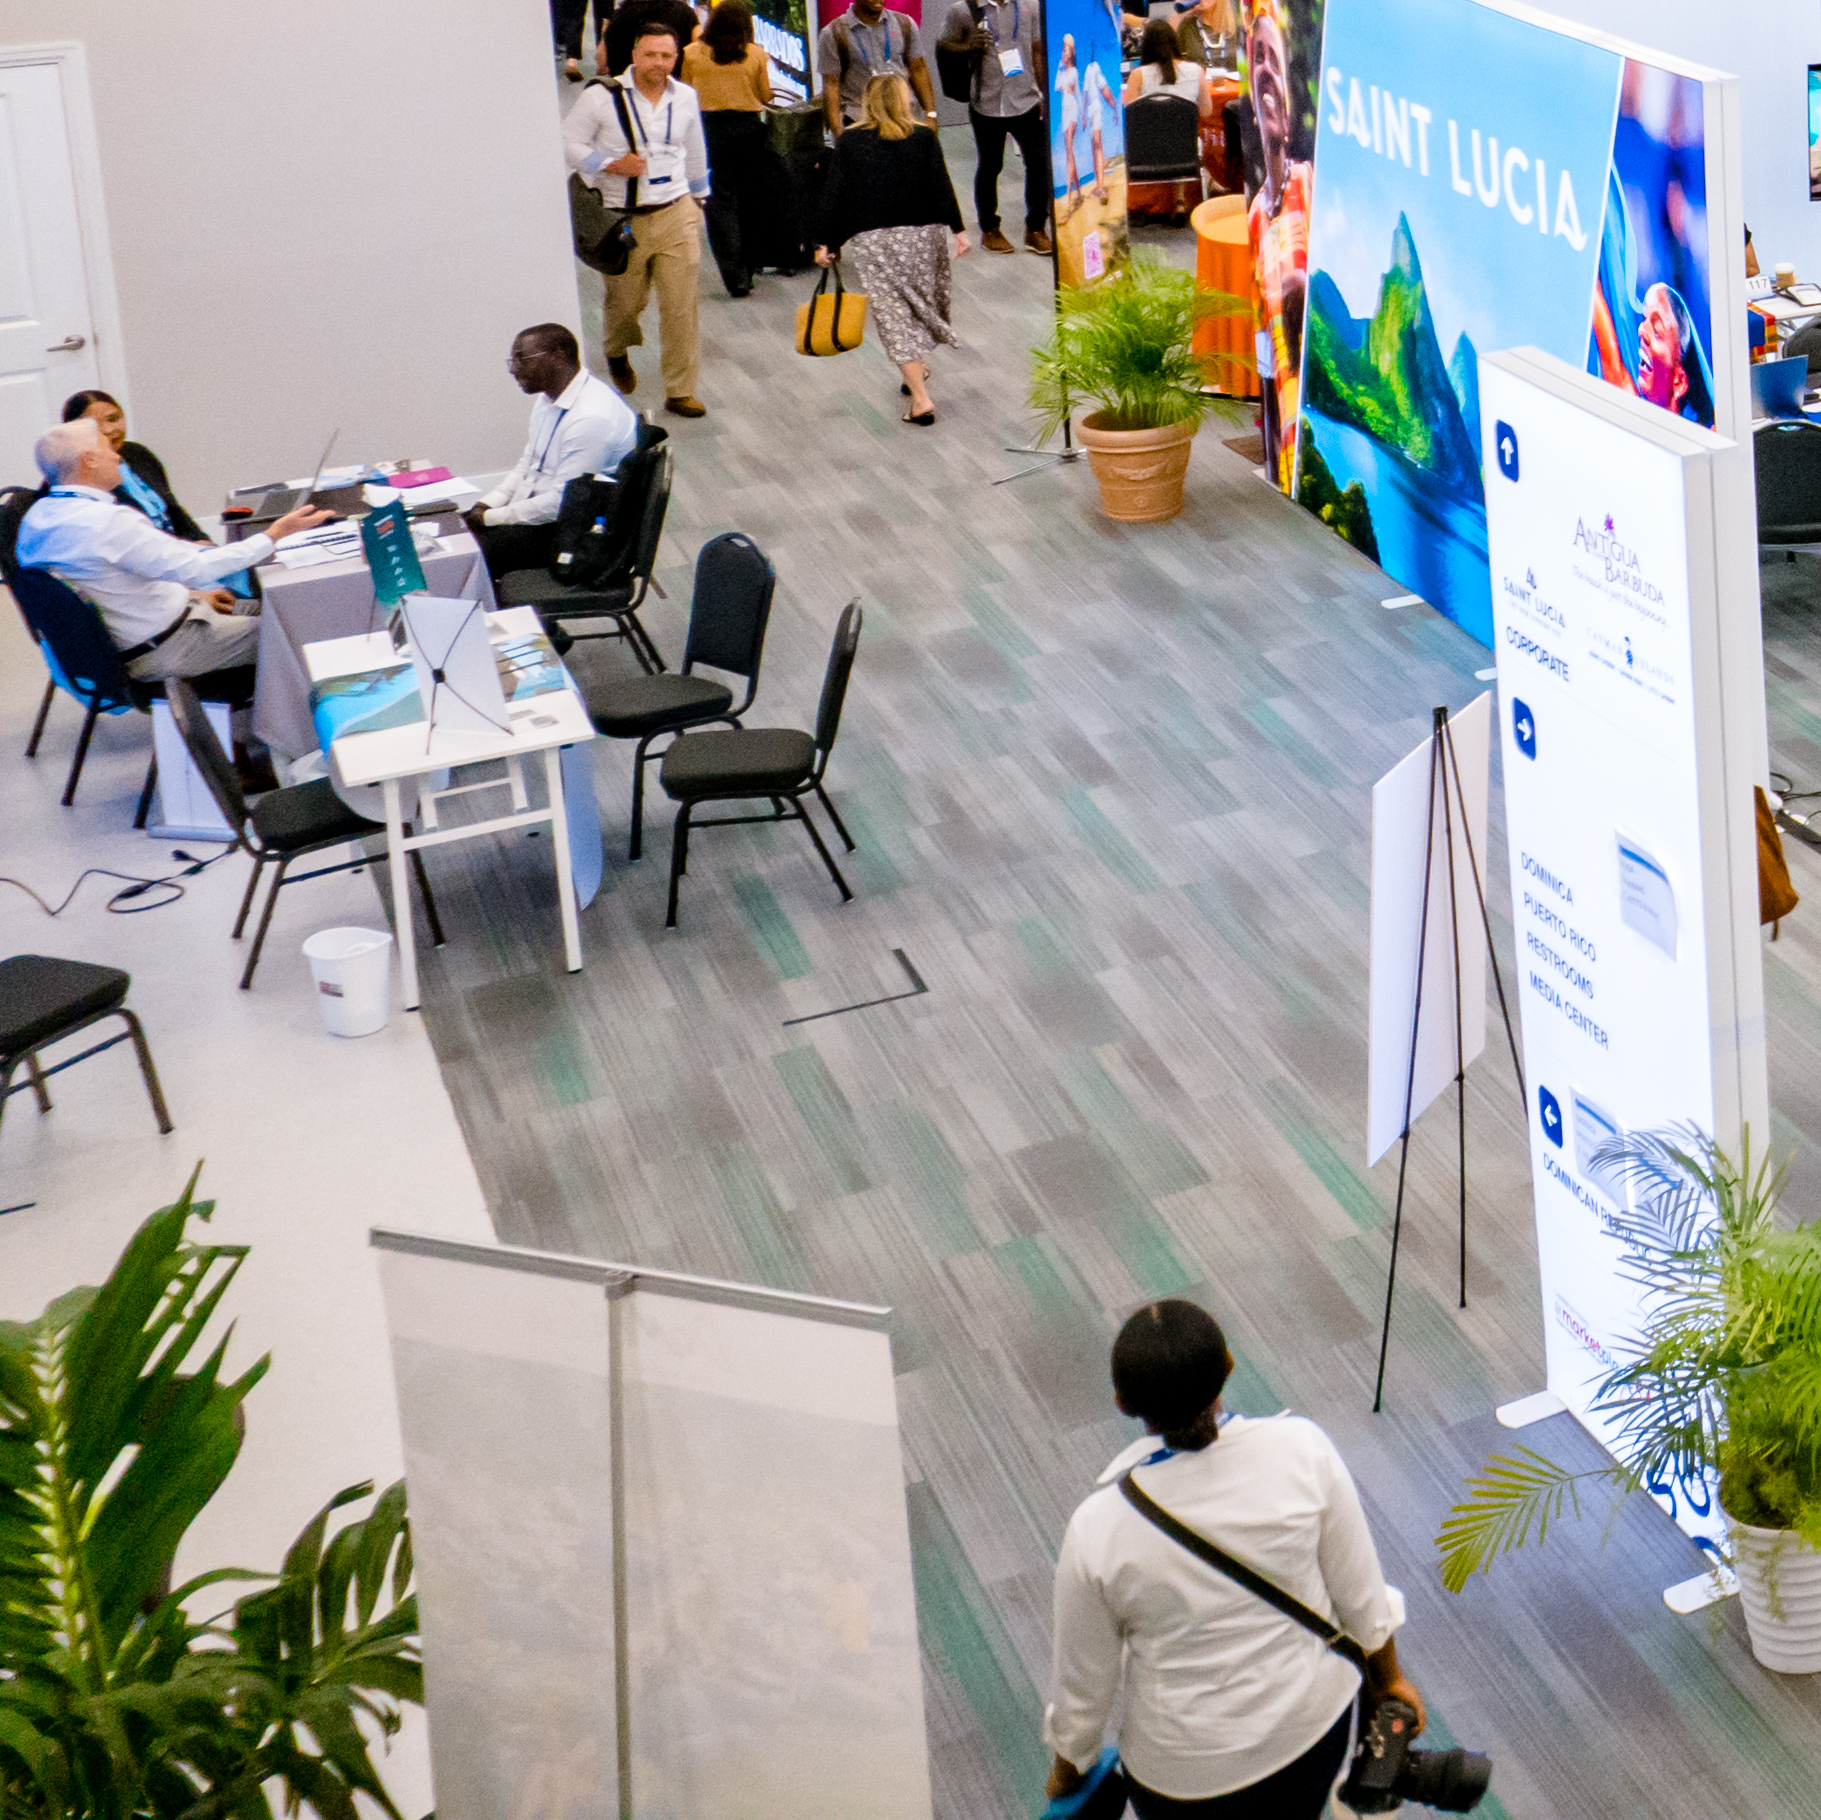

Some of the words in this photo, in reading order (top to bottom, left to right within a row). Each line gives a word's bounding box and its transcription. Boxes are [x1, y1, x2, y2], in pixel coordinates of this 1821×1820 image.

[1325, 64, 1433, 180] SAINT
[1448, 115, 1587, 253] LUCIA
[1748, 278, 1768, 291] 117
[1573, 515, 1641, 574] ANTIGUA
[1503, 576, 1531, 606] SAINT
[1535, 596, 1566, 629] LUCIA
[1604, 555, 1666, 608] BARBUDA
[1506, 625, 1570, 683] CORPORATE
[1520, 850, 1574, 907] DOMINICA
[1523, 890, 1567, 939] PUERTO
[1569, 927, 1597, 963] RICO
[1526, 930, 1595, 1000] RESTROOMS
[1529, 969, 1563, 1014] MEDIA
[1564, 1000, 1609, 1052] CENTER
[1543, 1151, 1599, 1218] DOMINICAN
